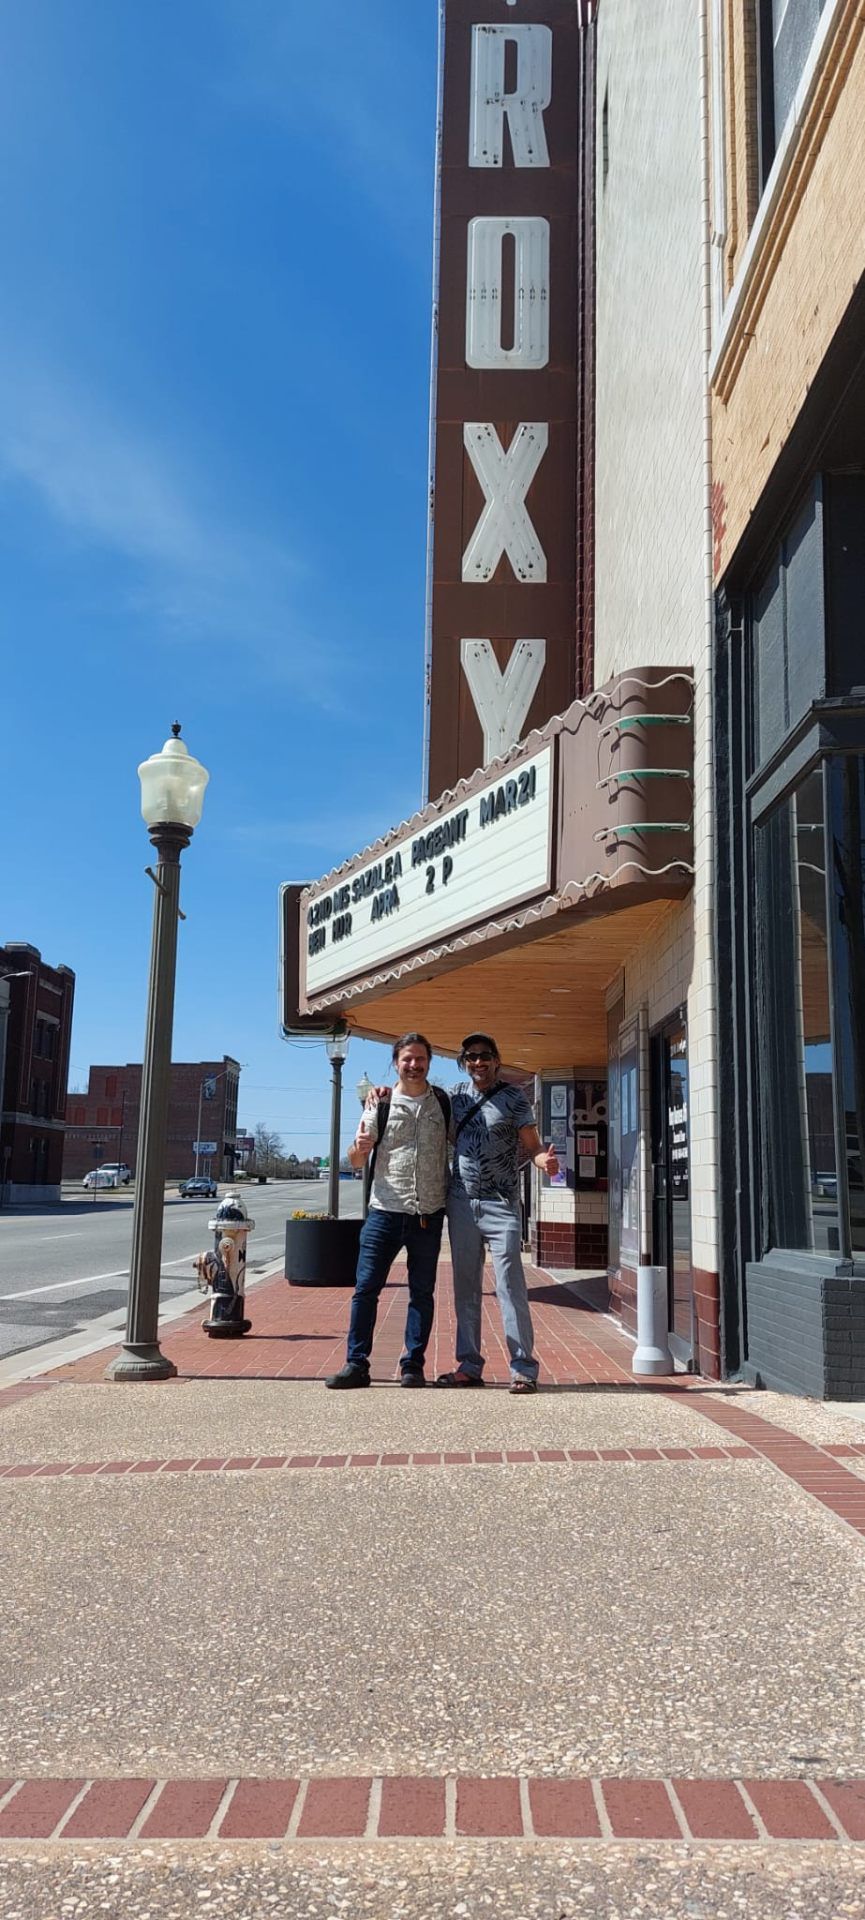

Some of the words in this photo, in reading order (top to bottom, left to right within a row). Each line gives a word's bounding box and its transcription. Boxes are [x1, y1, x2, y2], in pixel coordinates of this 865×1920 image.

[460, 22, 553, 766] ROXY
[411, 808, 469, 868] PAGEANT
[332, 912, 352, 944] HUR
[425, 865, 436, 896] 2
[442, 855, 453, 887] P
